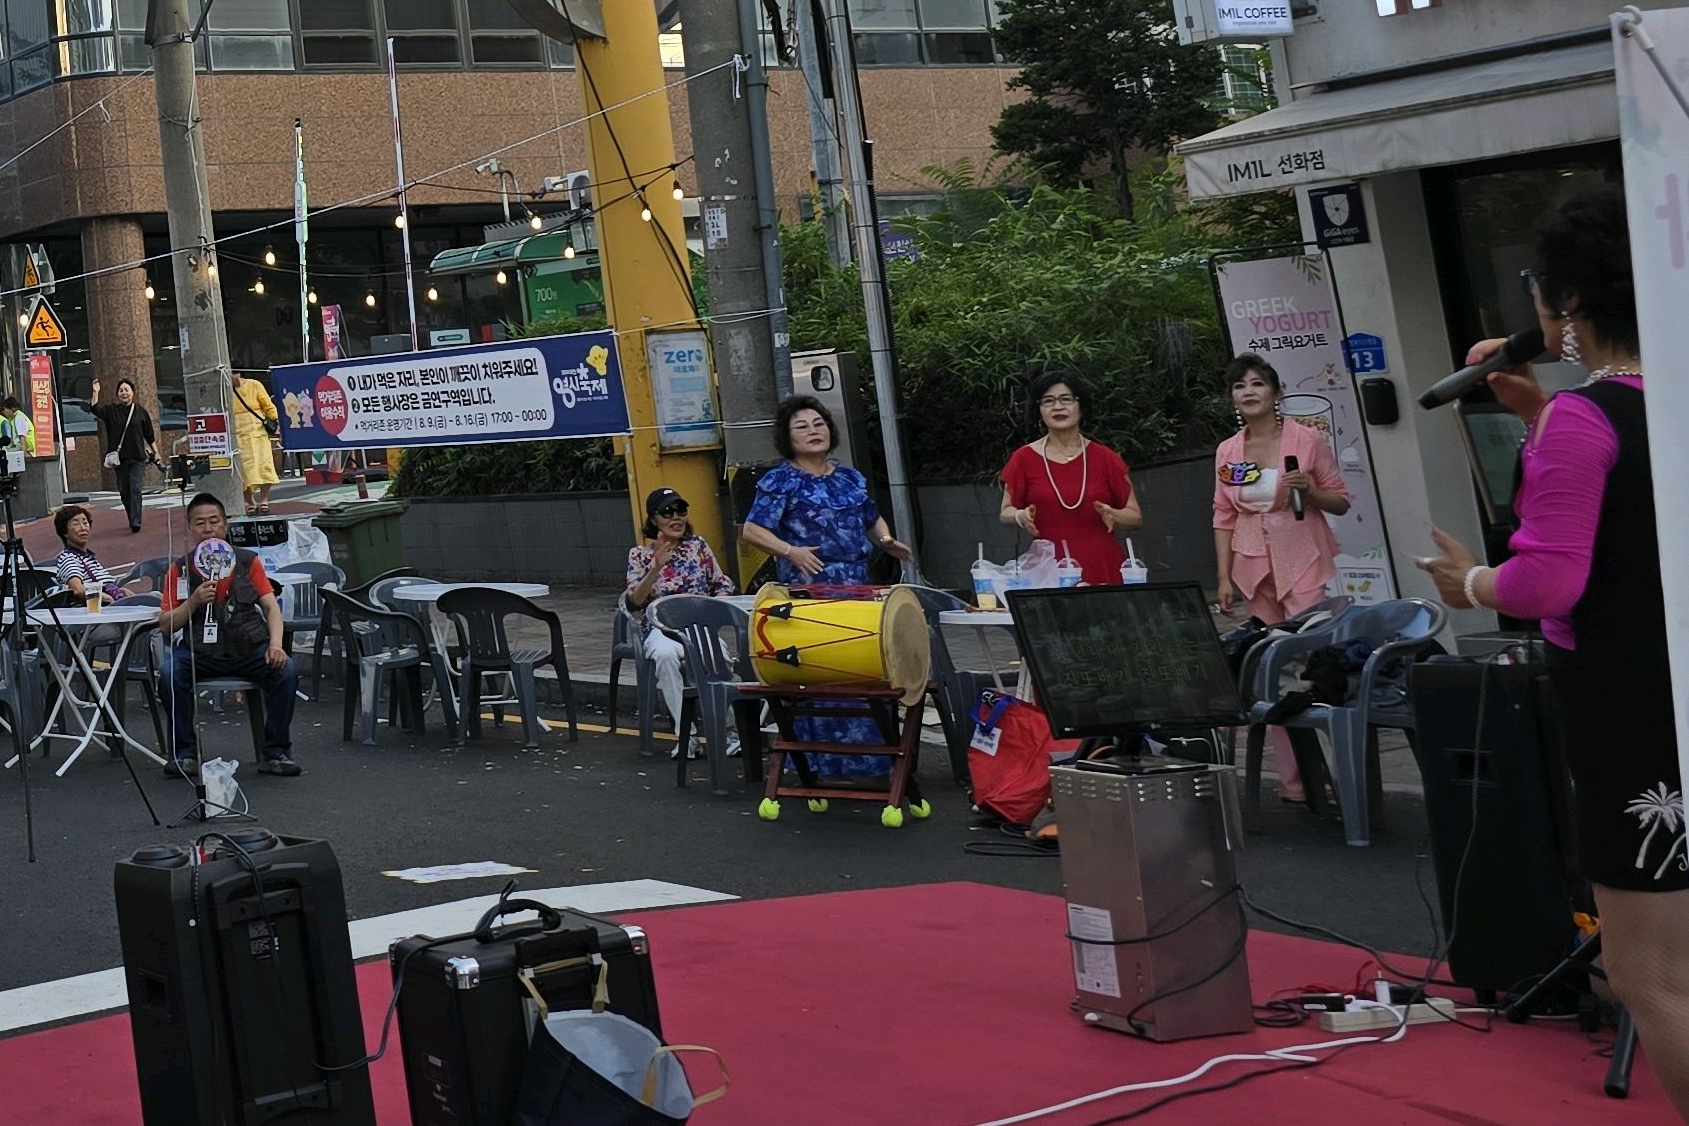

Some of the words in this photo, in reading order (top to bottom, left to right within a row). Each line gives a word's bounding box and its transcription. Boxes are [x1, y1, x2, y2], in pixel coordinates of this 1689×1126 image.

[1244, 7, 1288, 19] COFFEE
[1277, 149, 1325, 176] 선화점
[1231, 295, 1298, 319] GREEK
[1248, 310, 1331, 334] YOGURT
[1248, 337, 1271, 352] 수제
[1271, 333, 1329, 351] 그릭요거트
[1351, 351, 1374, 369] 13
[357, 374, 377, 390] 내가
[376, 371, 396, 389] 먹은
[419, 366, 449, 386] 본인이
[449, 363, 481, 382] 깨끗이
[482, 358, 538, 380] 치워주세요!
[361, 395, 380, 413] 모든
[380, 392, 420, 412] 행사장은
[420, 386, 495, 410] 금연구역입니다.
[386, 417, 412, 431] 운영기간
